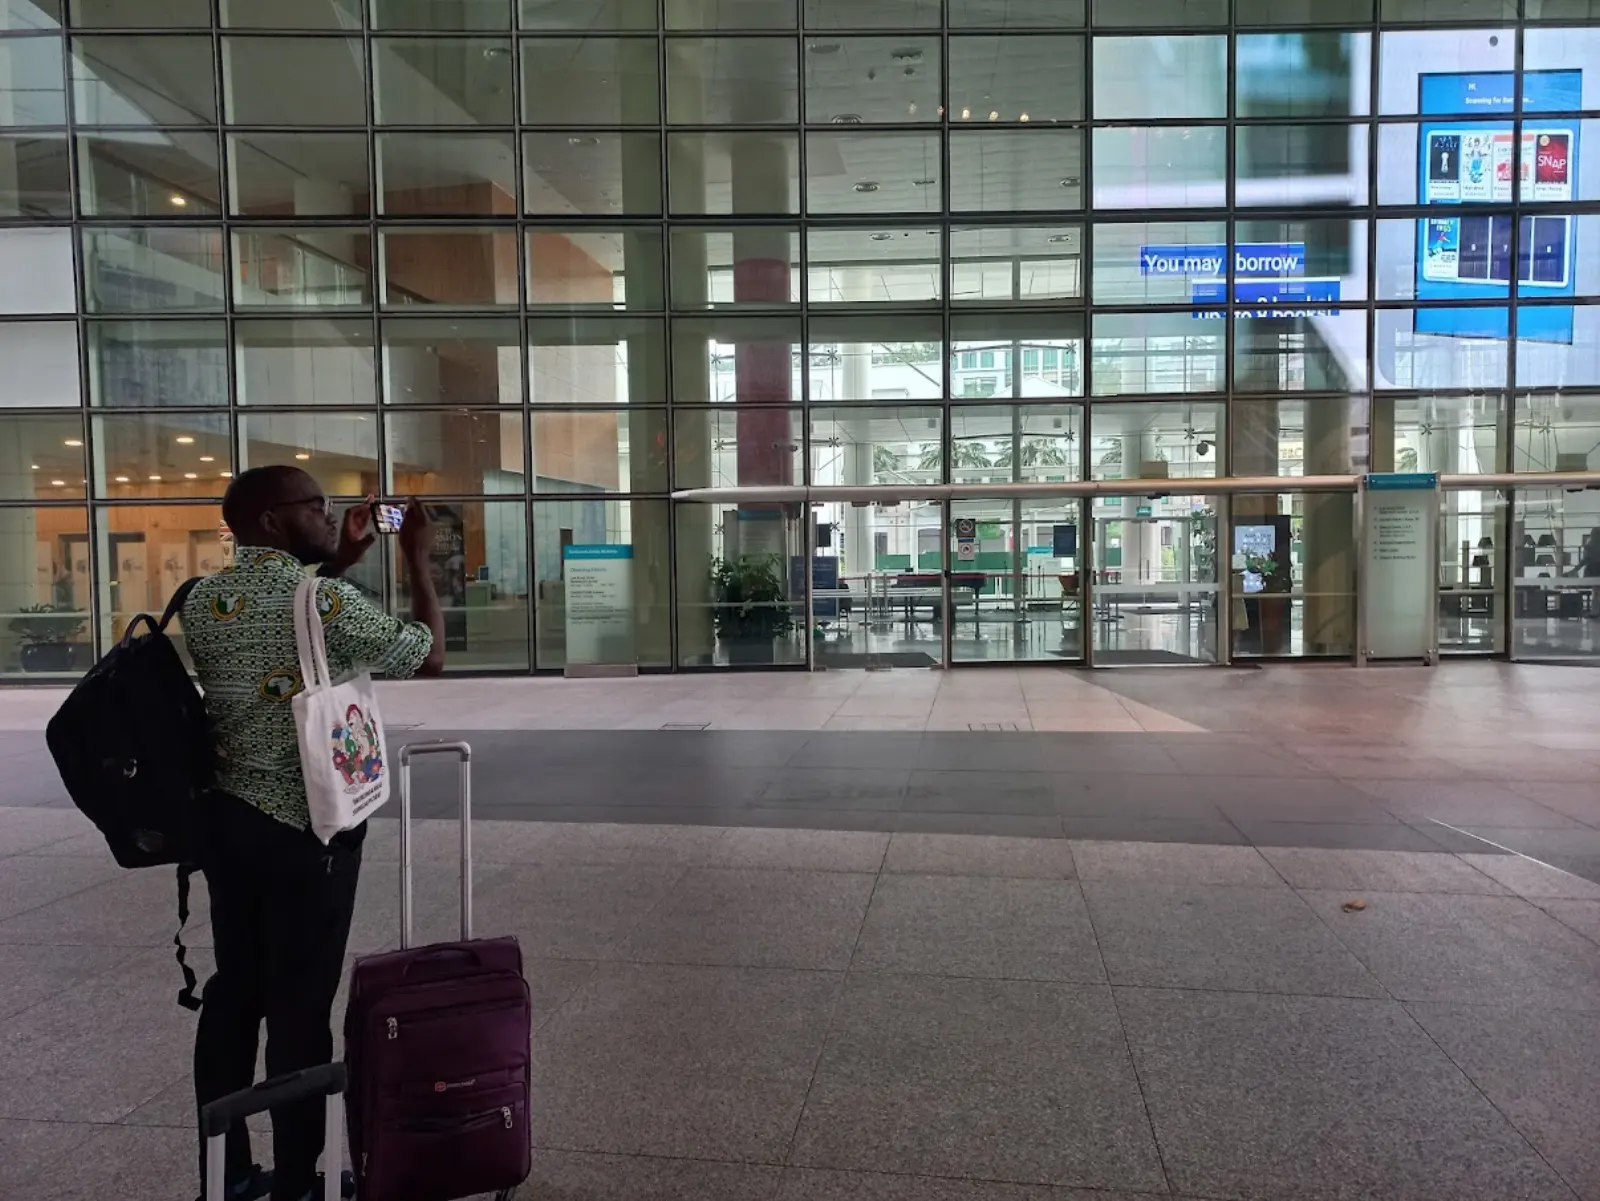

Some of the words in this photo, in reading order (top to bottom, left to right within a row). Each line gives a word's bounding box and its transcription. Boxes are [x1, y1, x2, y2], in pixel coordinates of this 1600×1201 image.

[1538, 154, 1567, 170] SNAP
[1144, 254, 1178, 272] You
[1184, 256, 1222, 276] may
[1235, 253, 1298, 272] borrow
